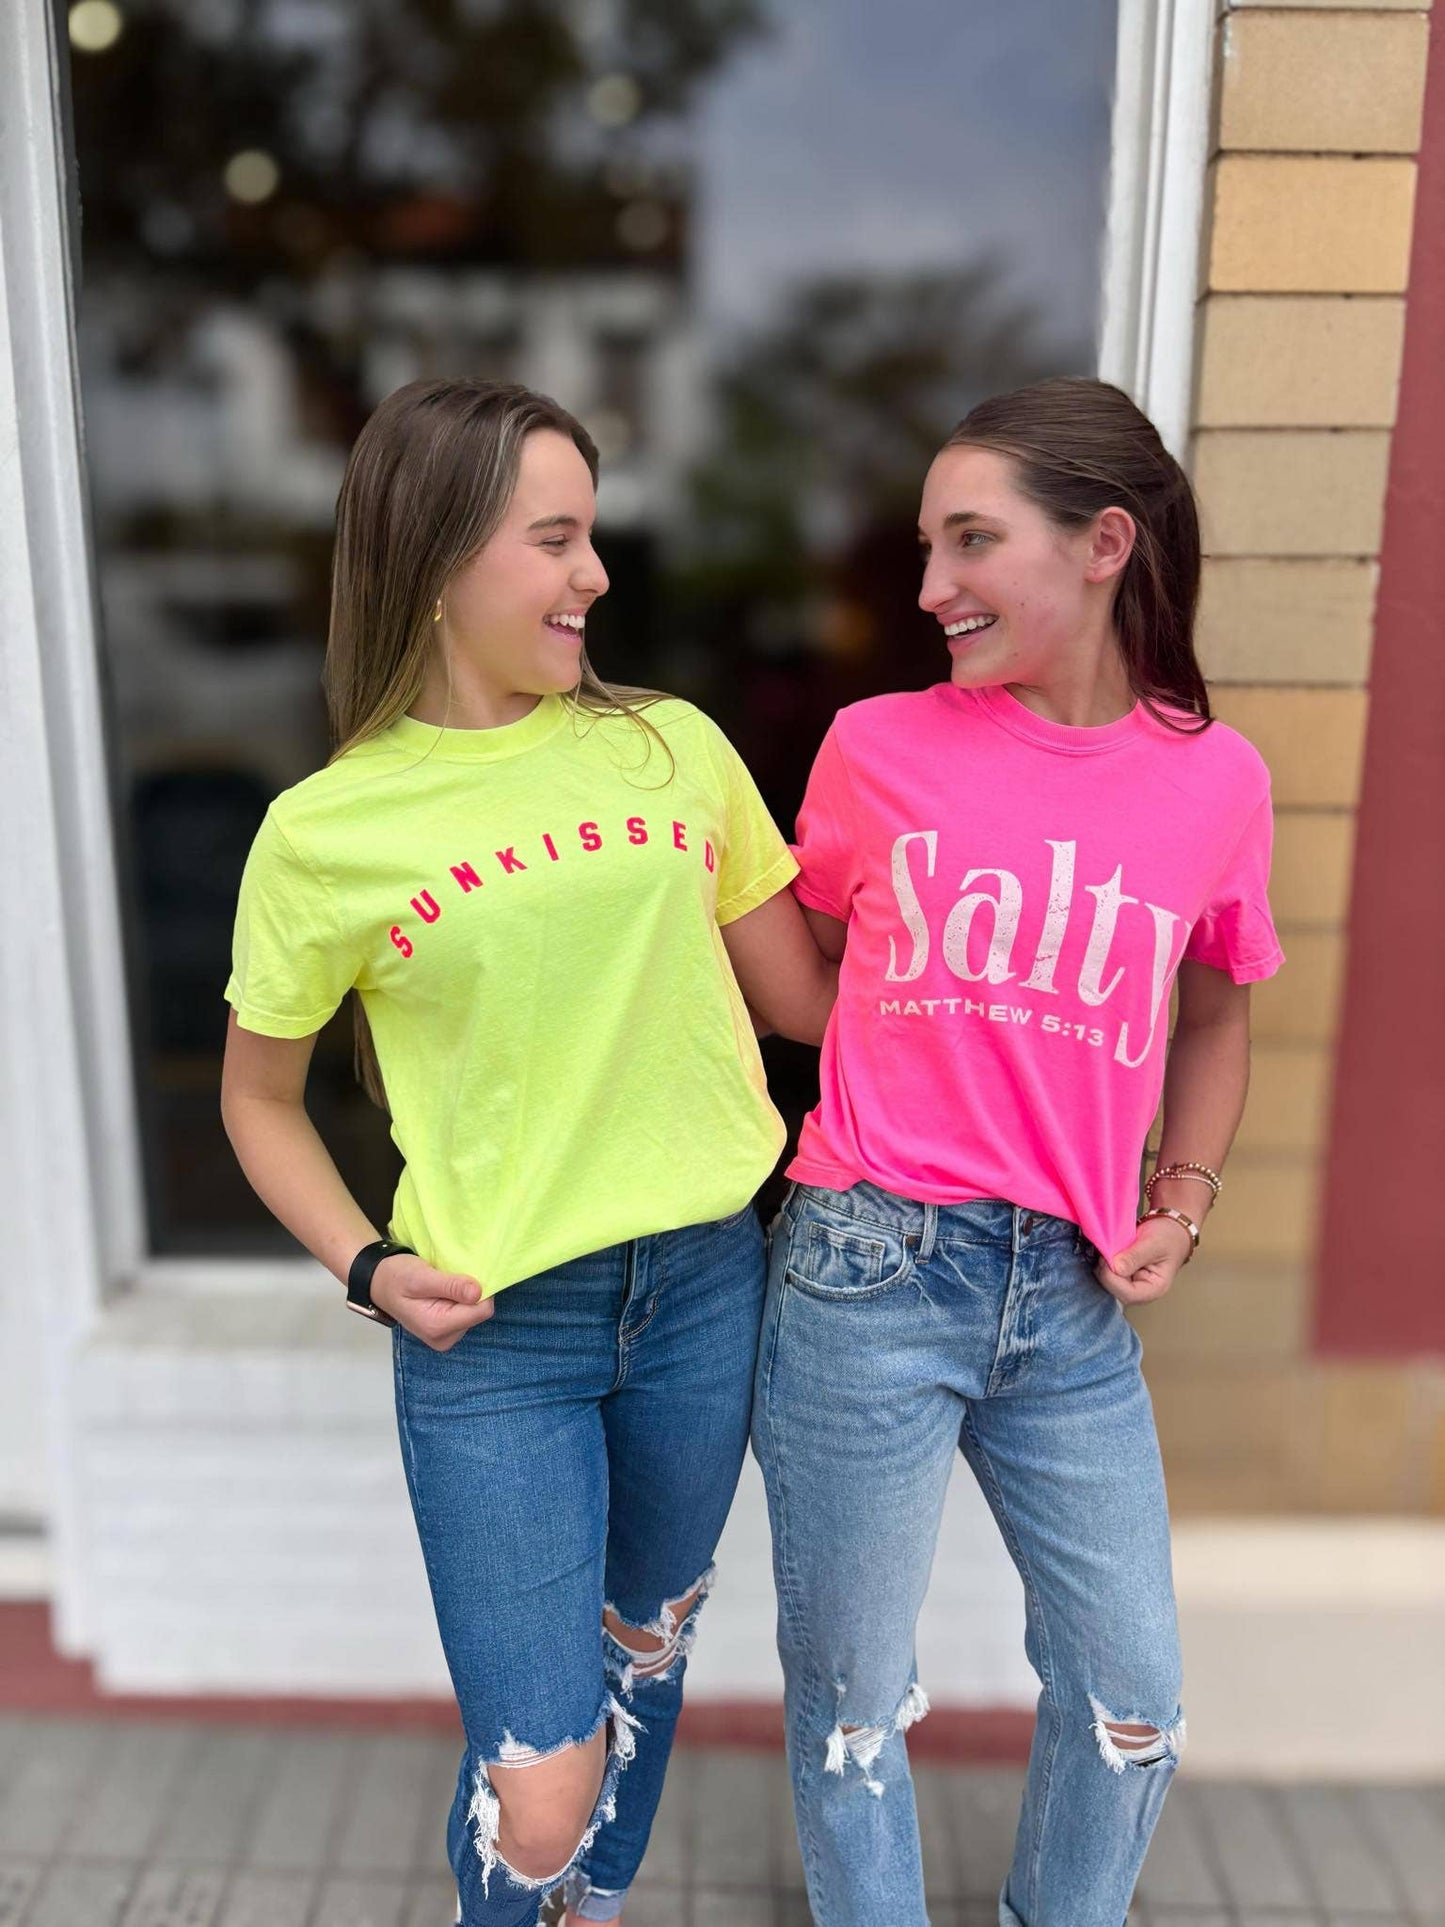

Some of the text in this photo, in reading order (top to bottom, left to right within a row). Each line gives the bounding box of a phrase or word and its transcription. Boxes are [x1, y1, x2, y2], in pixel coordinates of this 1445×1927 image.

[389, 816, 715, 959] SUNKISSED
[885, 830, 1193, 1068] Salty
[879, 998, 1105, 1047] MATTHEW 5:13
